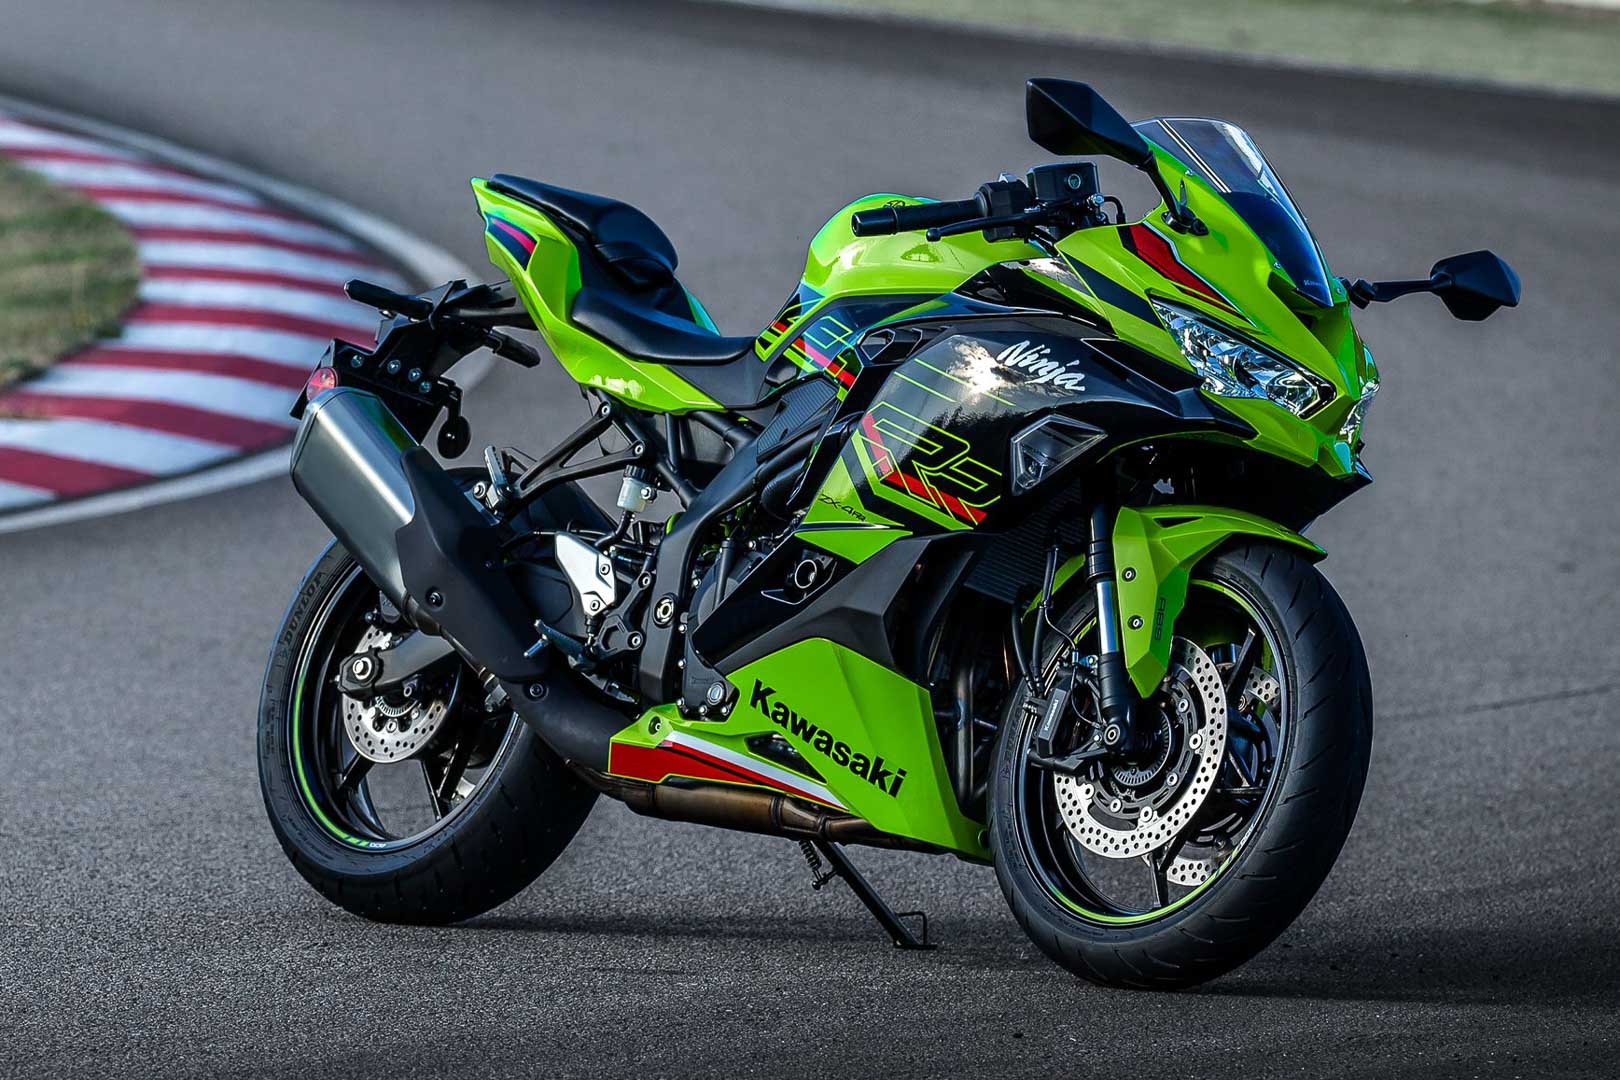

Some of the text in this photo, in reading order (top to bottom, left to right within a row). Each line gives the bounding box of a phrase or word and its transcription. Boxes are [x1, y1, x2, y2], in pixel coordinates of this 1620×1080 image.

[995, 340, 1087, 393] Ninja
[284, 570, 327, 646] DUNLOP
[1154, 596, 1168, 641] ABS
[749, 678, 908, 799] Kawasaki
